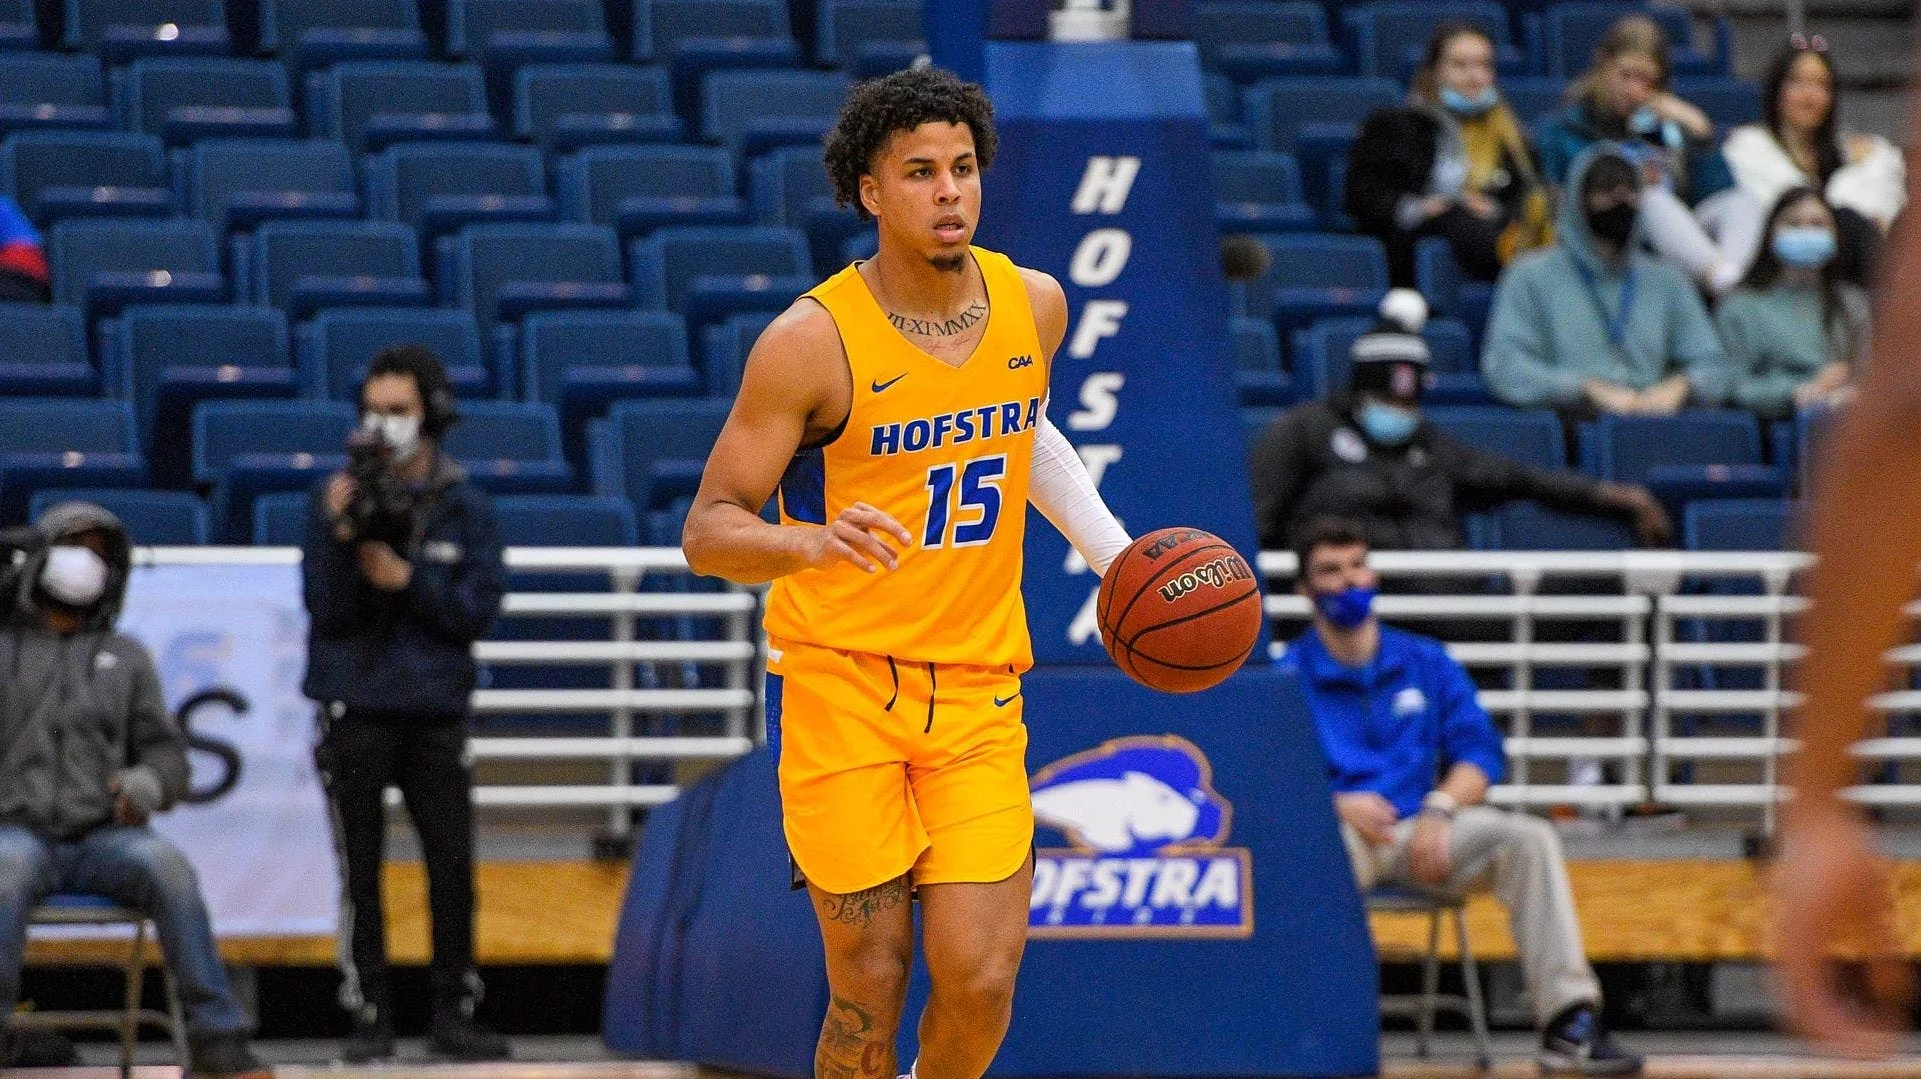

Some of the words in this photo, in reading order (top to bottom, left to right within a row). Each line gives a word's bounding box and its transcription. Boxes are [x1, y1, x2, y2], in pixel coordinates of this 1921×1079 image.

[1008, 354, 1033, 370] CAA
[869, 397, 1040, 457] HOFSTRA
[1064, 156, 1141, 646] HOFST
[921, 453, 1008, 548] 15
[1157, 556, 1251, 603] Wilson
[1030, 857, 1240, 909] OFSTRA
